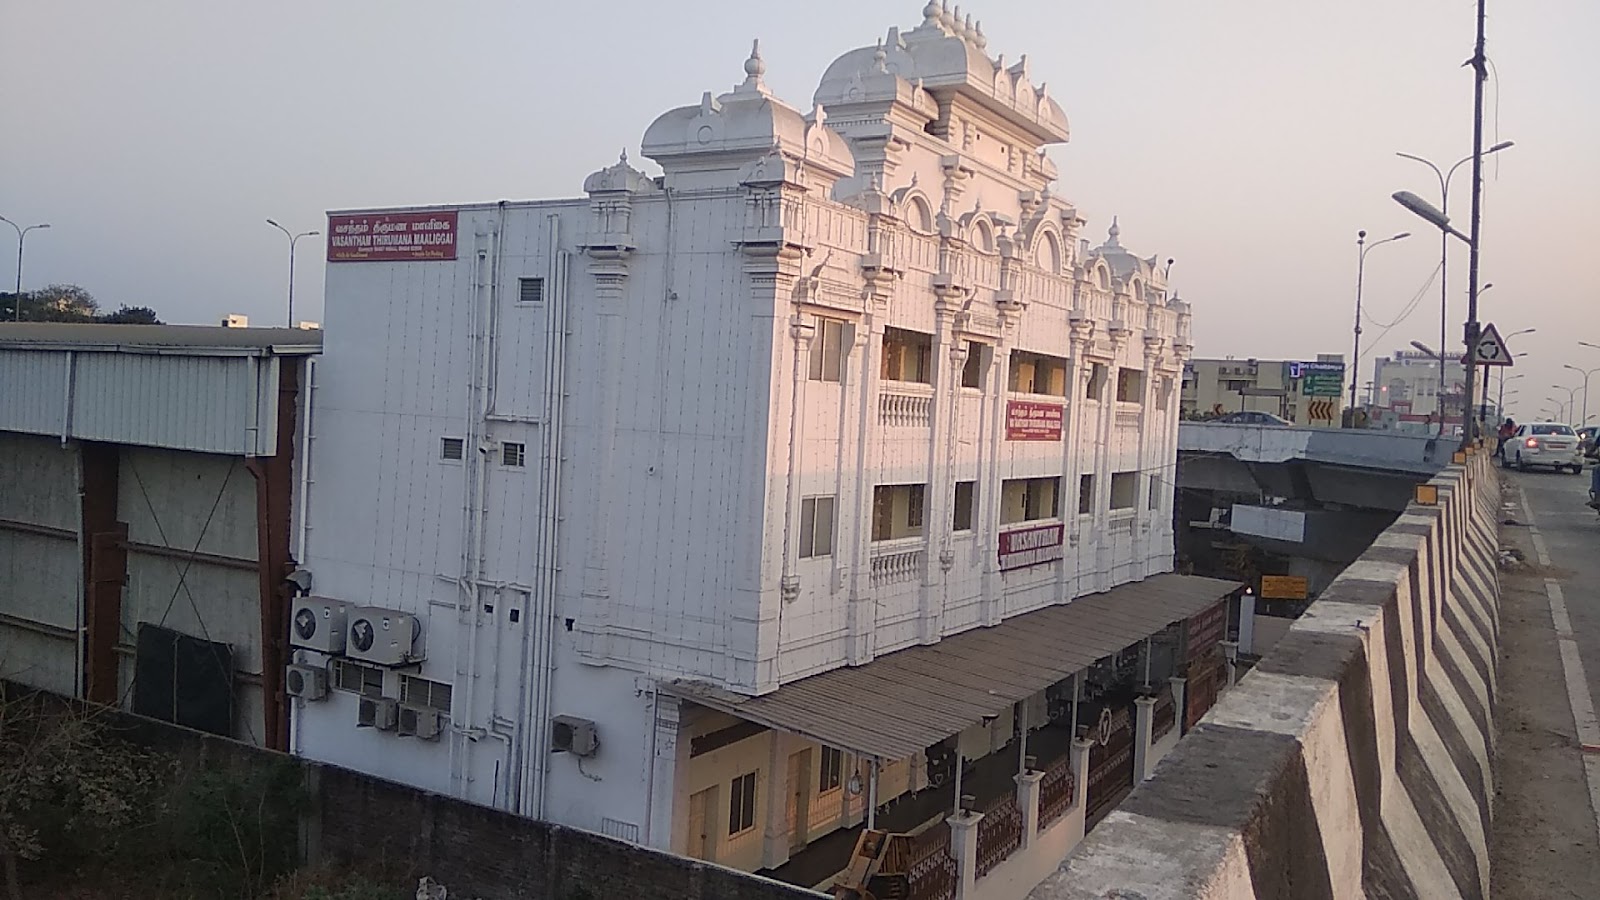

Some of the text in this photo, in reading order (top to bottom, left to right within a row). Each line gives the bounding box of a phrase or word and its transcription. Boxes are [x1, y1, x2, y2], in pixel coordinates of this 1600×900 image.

[331, 232, 453, 247] VASANTHAM THIRUMANA MAALIGGAI
